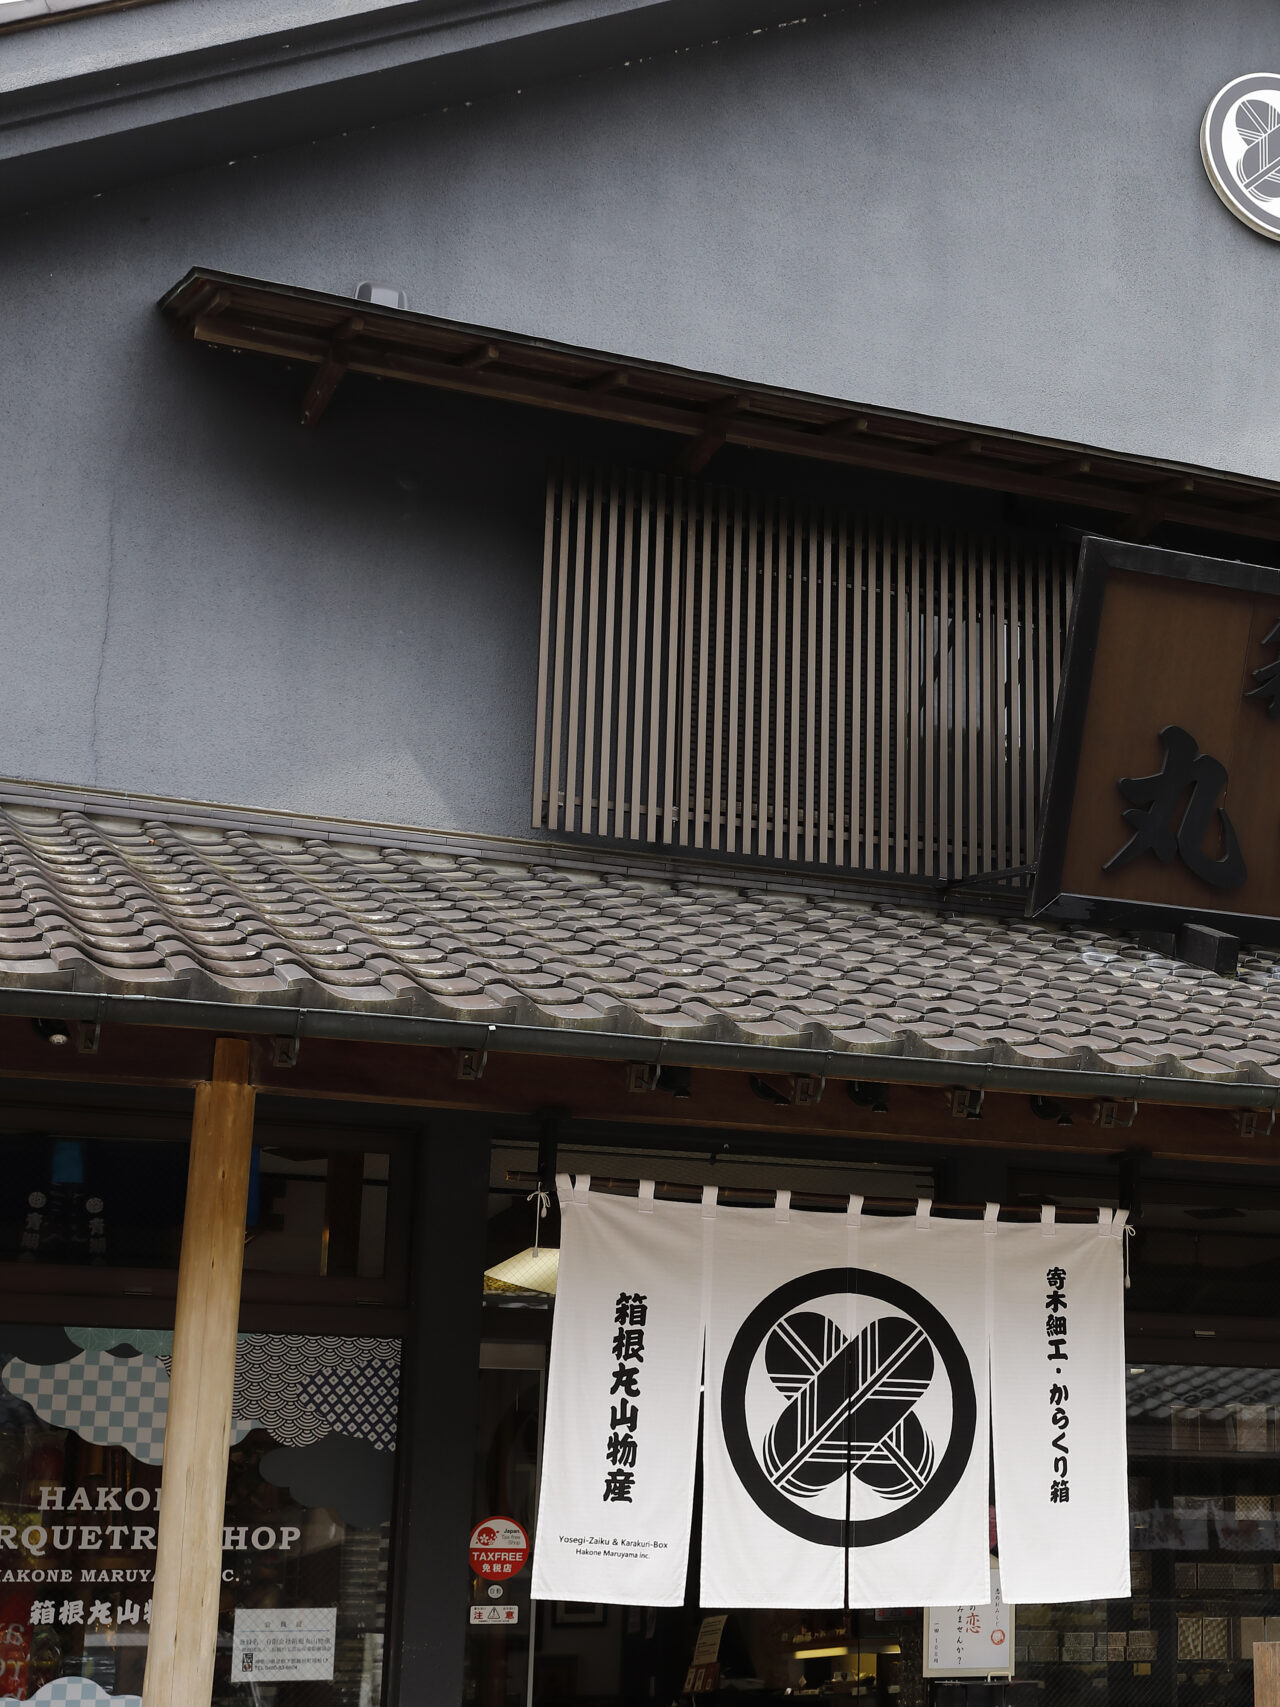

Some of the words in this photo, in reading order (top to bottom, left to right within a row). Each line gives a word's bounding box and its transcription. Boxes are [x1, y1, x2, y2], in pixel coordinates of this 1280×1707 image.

[1045, 1266, 1070, 1503] 寄木細工・からくり箱
[602, 1292, 648, 1504] 箱根丸山物産
[37, 1486, 162, 1512] HAKO
[0, 1525, 158, 1556] RQUETR
[222, 1526, 302, 1551] HOP
[559, 1535, 610, 1547] Yosegi-Zaiku
[612, 1538, 619, 1546] &
[621, 1538, 668, 1549] Karakuri-Box
[472, 1551, 524, 1562] TAXFREE
[575, 1548, 602, 1556] Hakone
[603, 1550, 638, 1560] Maruyama
[80, 1568, 156, 1583] MARUY
[481, 1563, 513, 1573] 免税店
[29, 1599, 153, 1626] 箱根丸山
